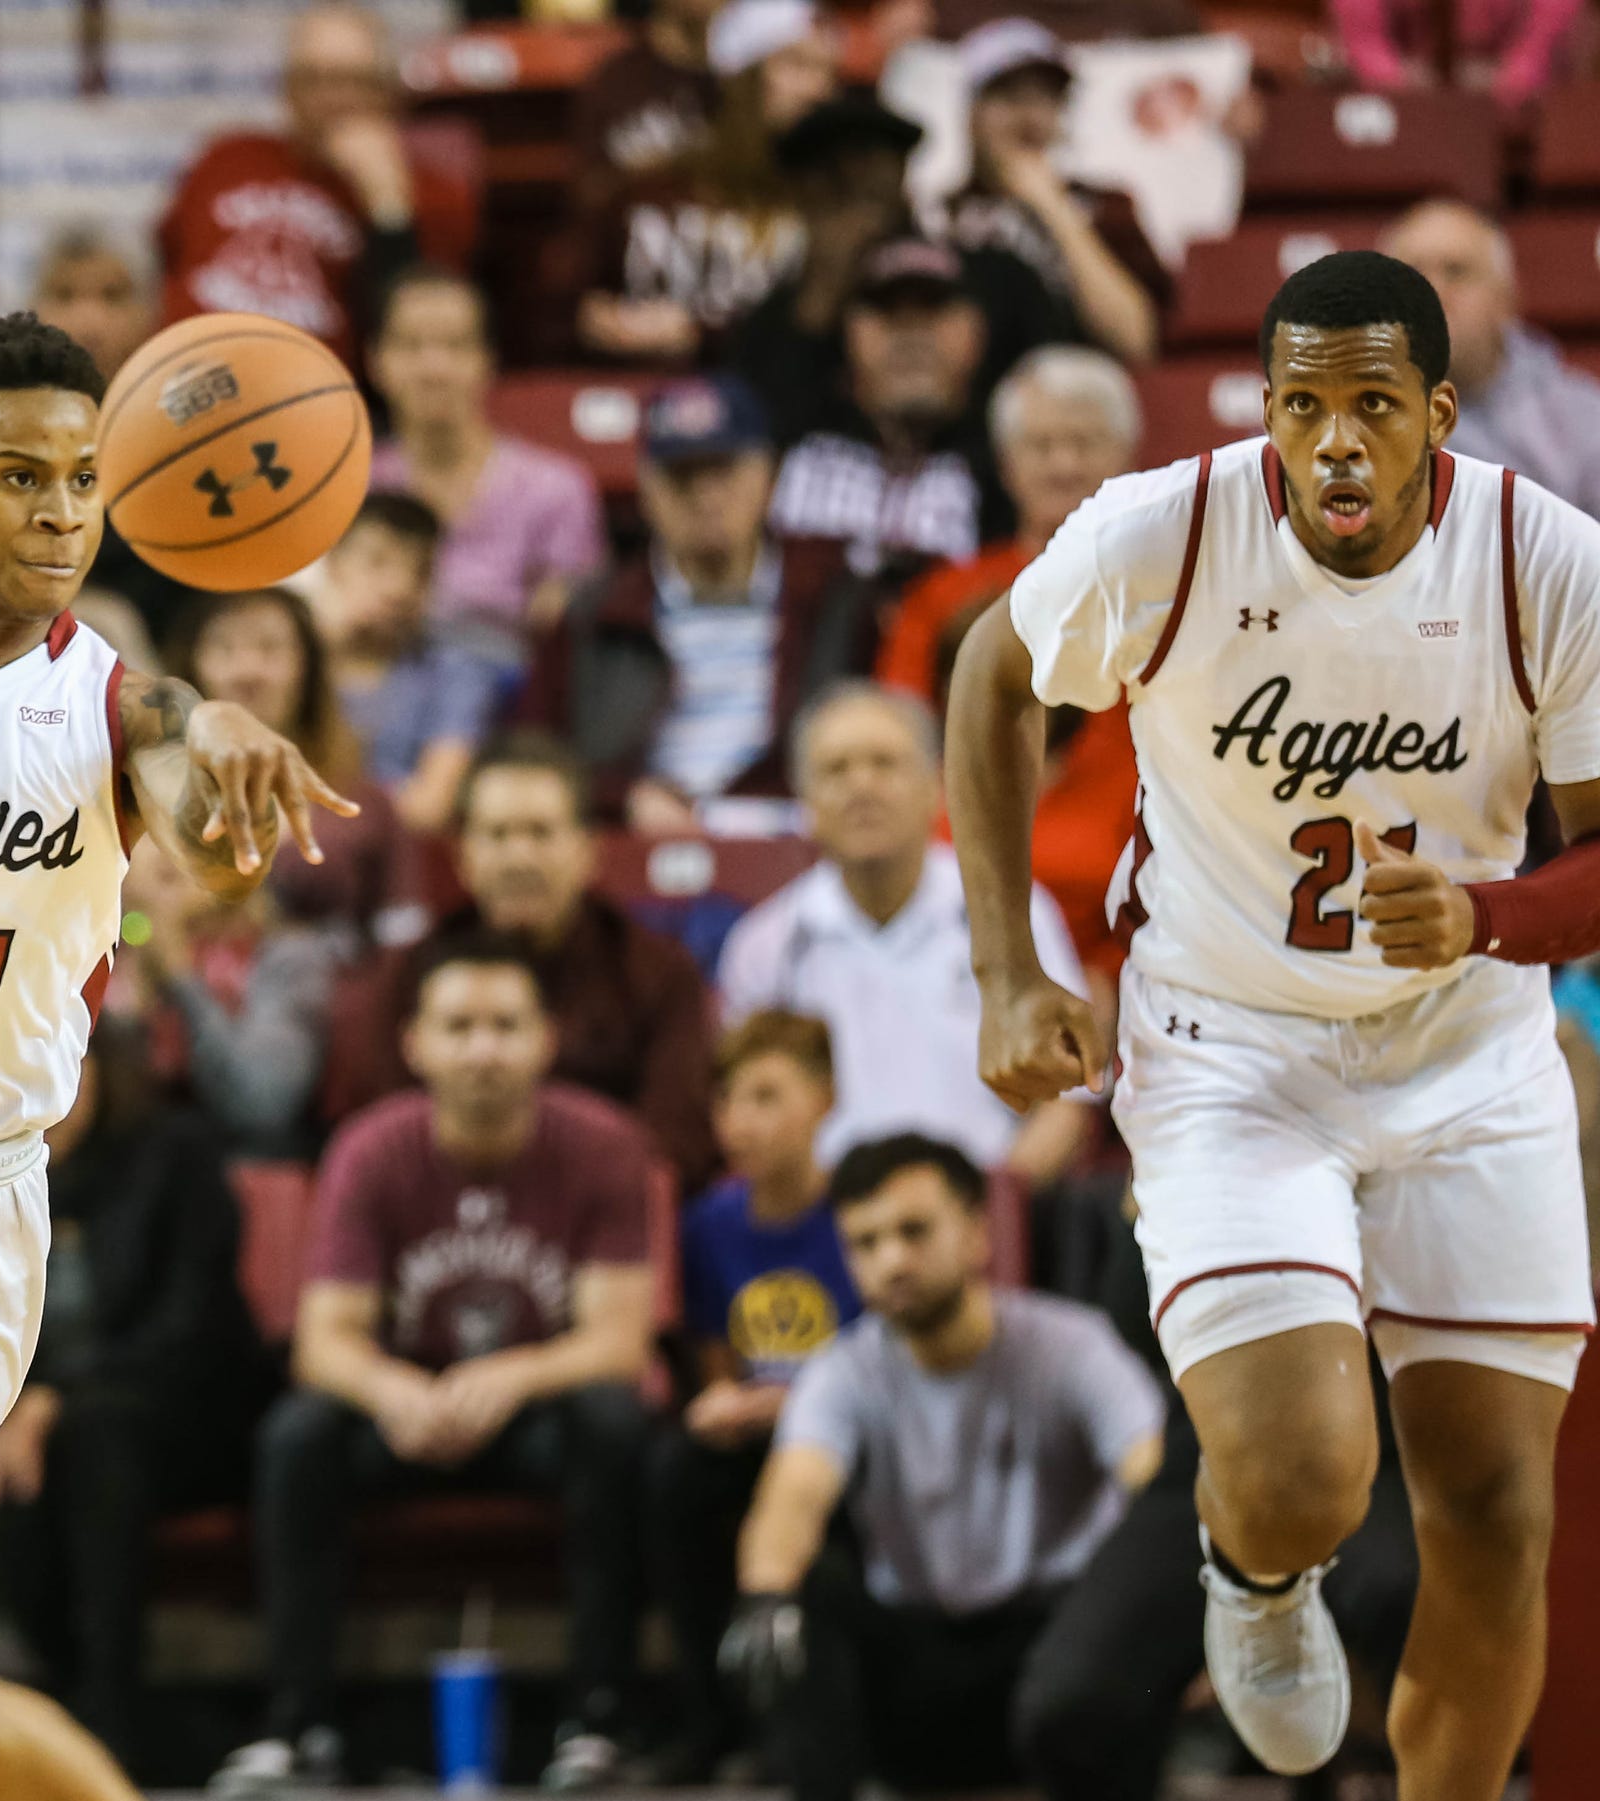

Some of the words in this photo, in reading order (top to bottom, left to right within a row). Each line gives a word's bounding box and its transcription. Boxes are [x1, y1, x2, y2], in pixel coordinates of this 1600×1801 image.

[19, 706, 66, 725] WAC
[1212, 675, 1469, 800] Aggies
[1286, 816, 1416, 952] 2
